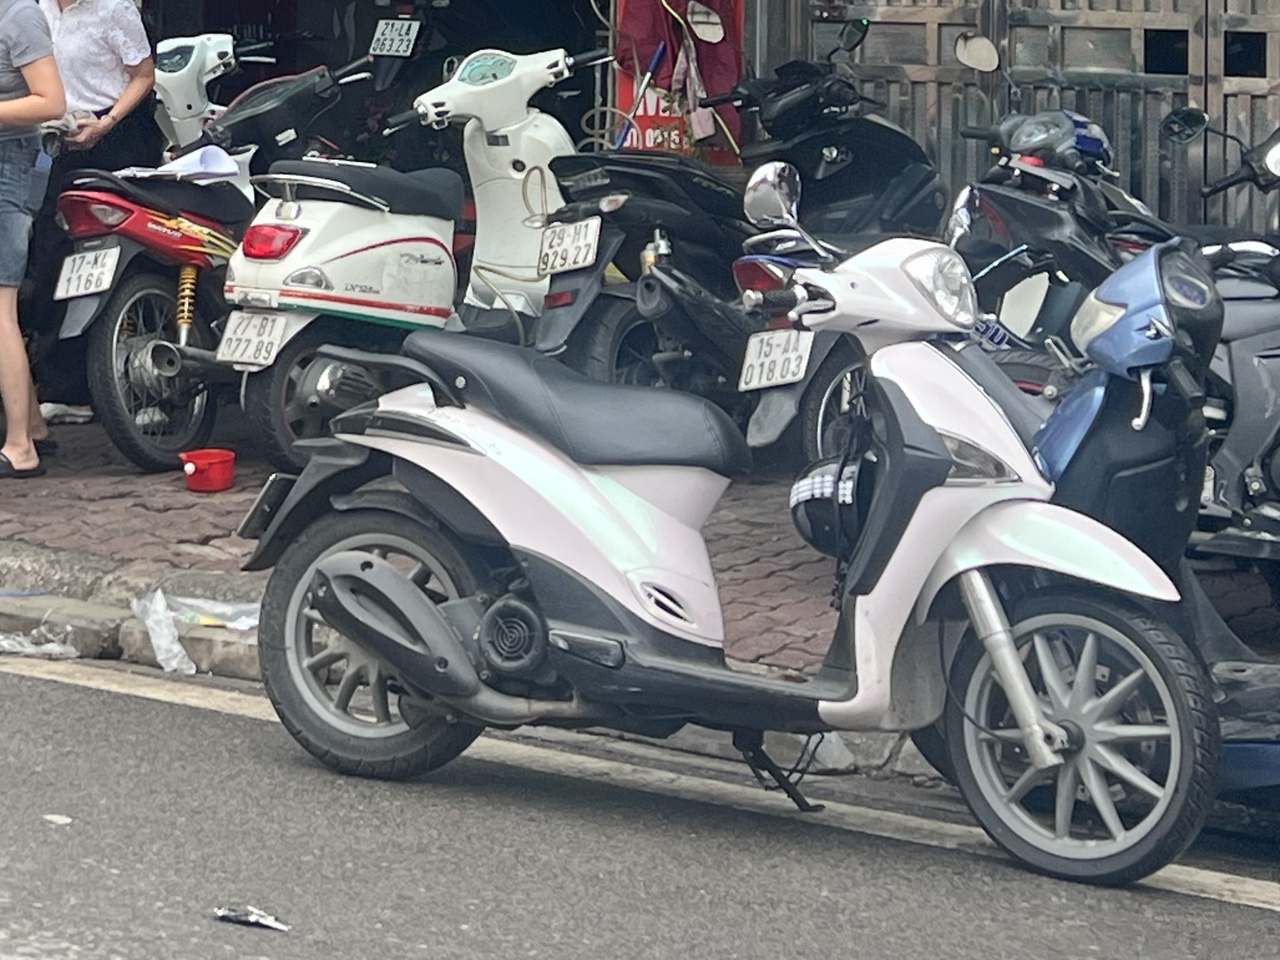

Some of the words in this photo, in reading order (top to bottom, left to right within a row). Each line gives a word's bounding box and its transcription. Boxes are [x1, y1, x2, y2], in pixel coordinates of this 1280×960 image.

[548, 223, 590, 249] 29-H1
[540, 243, 591, 271] 929.27
[65, 270, 106, 295] 1166
[744, 355, 803, 386] 018.03
